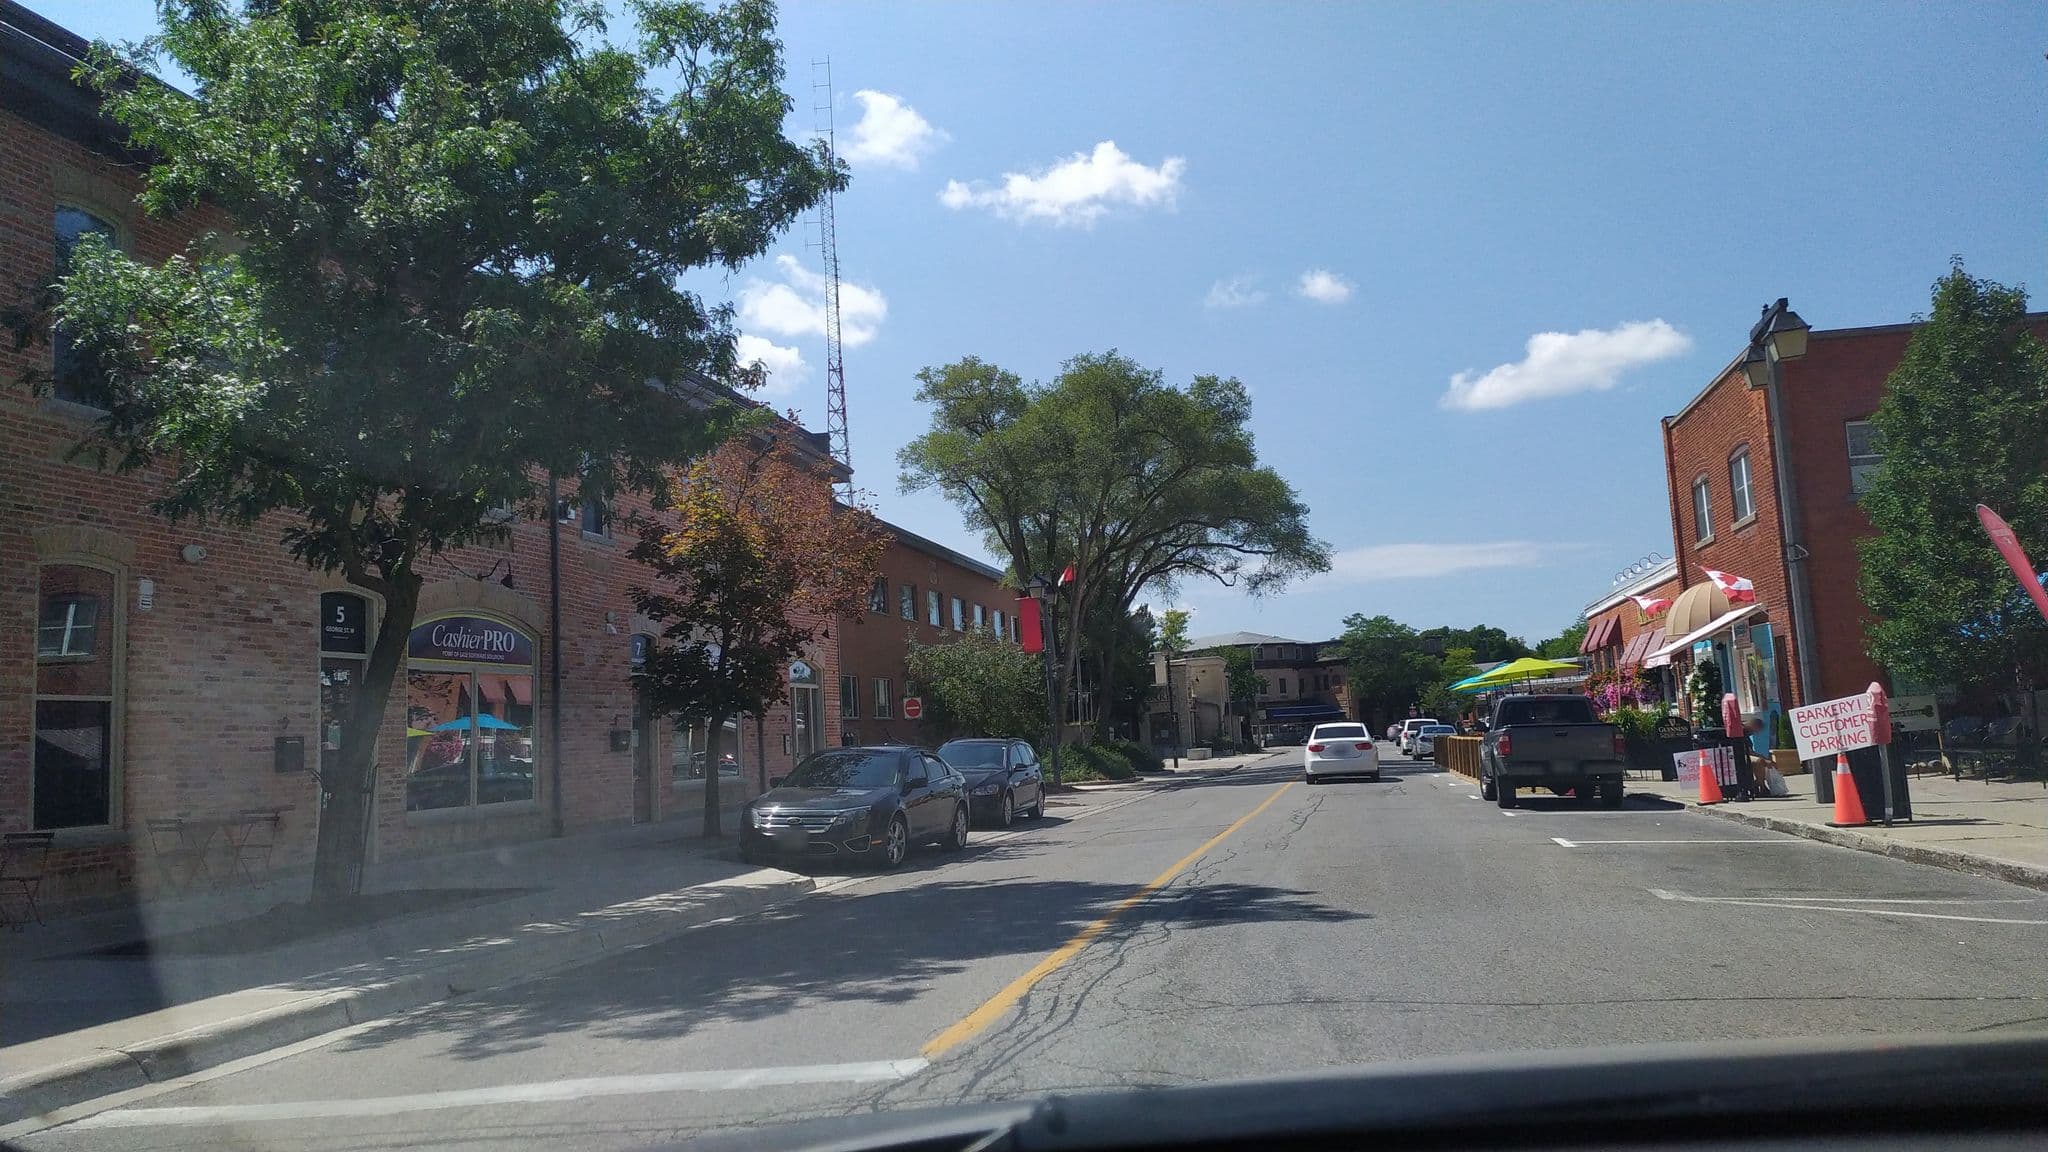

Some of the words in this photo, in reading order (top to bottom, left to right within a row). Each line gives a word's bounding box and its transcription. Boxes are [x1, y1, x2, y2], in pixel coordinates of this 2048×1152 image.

[336, 606, 345, 623] 5
[432, 624, 515, 652] CashierPRO
[636, 642, 641, 656] 7
[1800, 713, 1868, 738] CUSTOMER
[1811, 730, 1867, 753] PARKING
